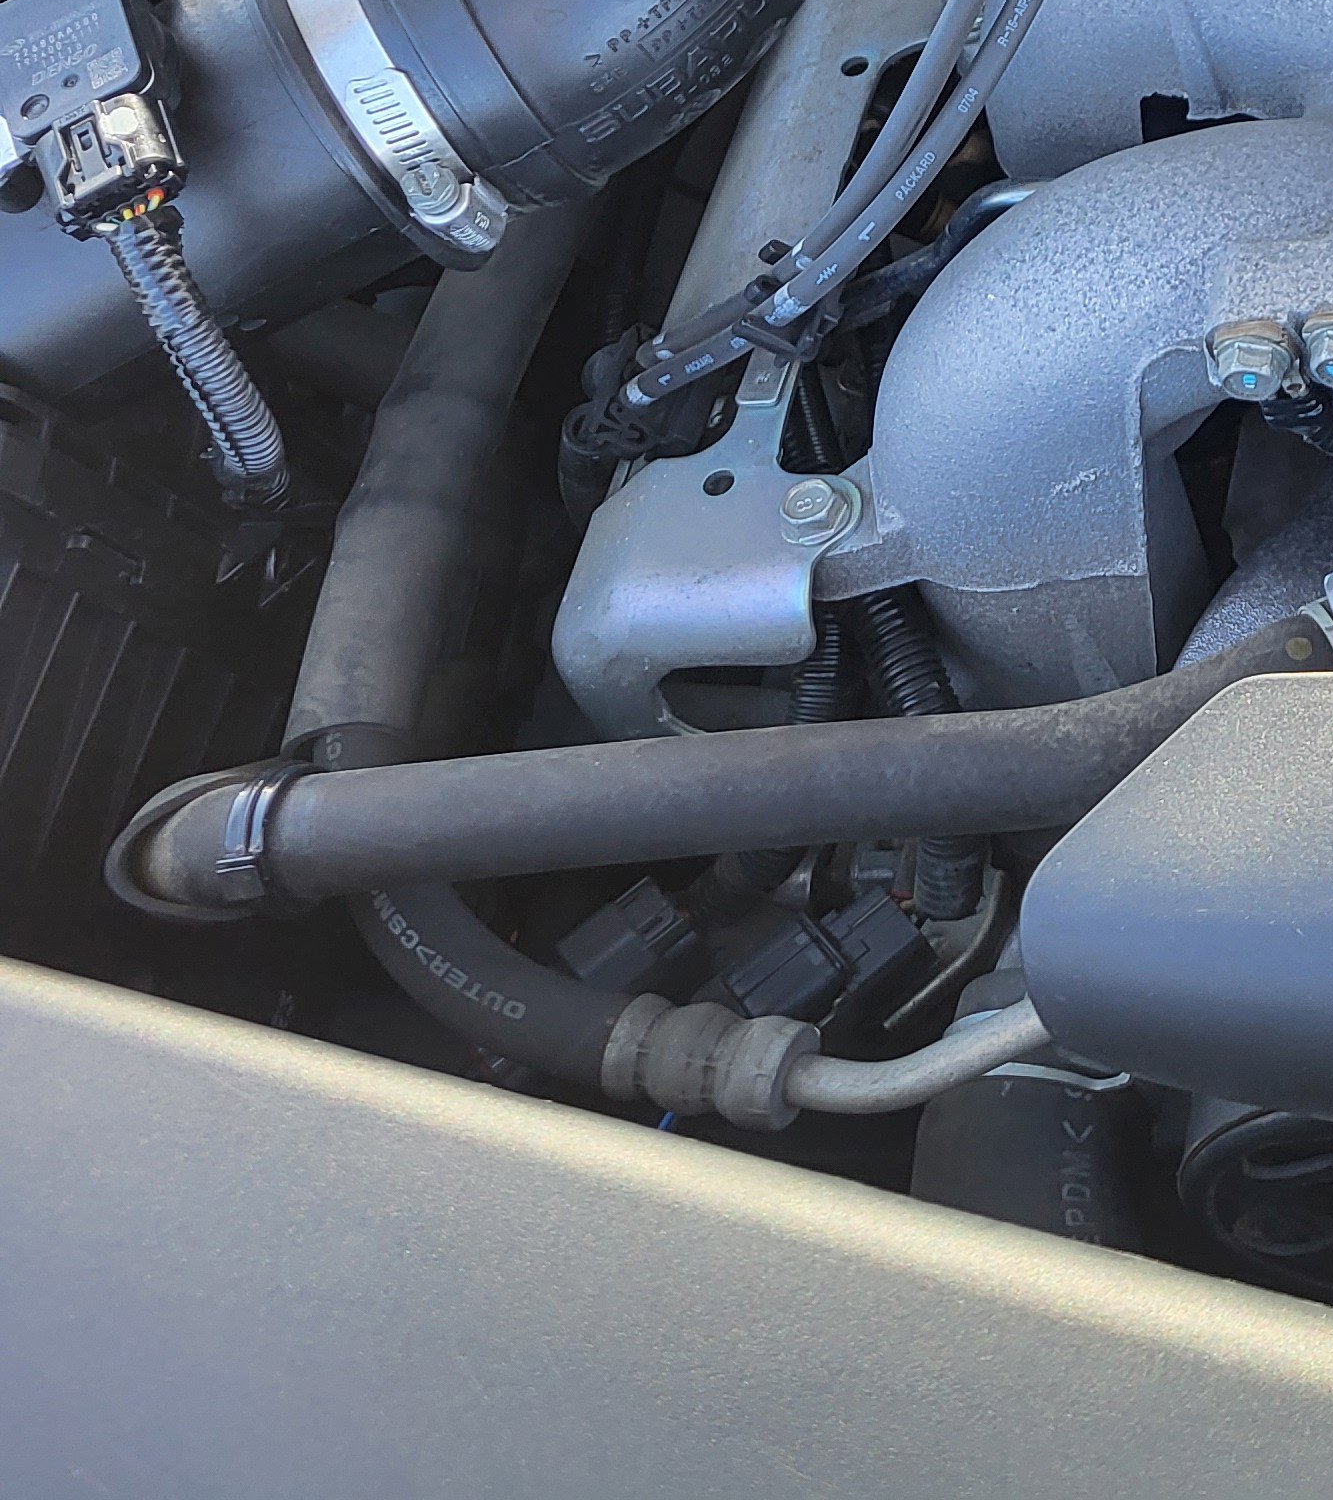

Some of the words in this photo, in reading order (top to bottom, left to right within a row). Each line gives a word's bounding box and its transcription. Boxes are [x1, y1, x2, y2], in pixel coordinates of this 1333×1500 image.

[31, 43, 97, 86] DENSO
[957, 87, 979, 113] 0704
[895, 151, 936, 201] PACKARD
[370, 889, 527, 1020] OUTER>CSM
